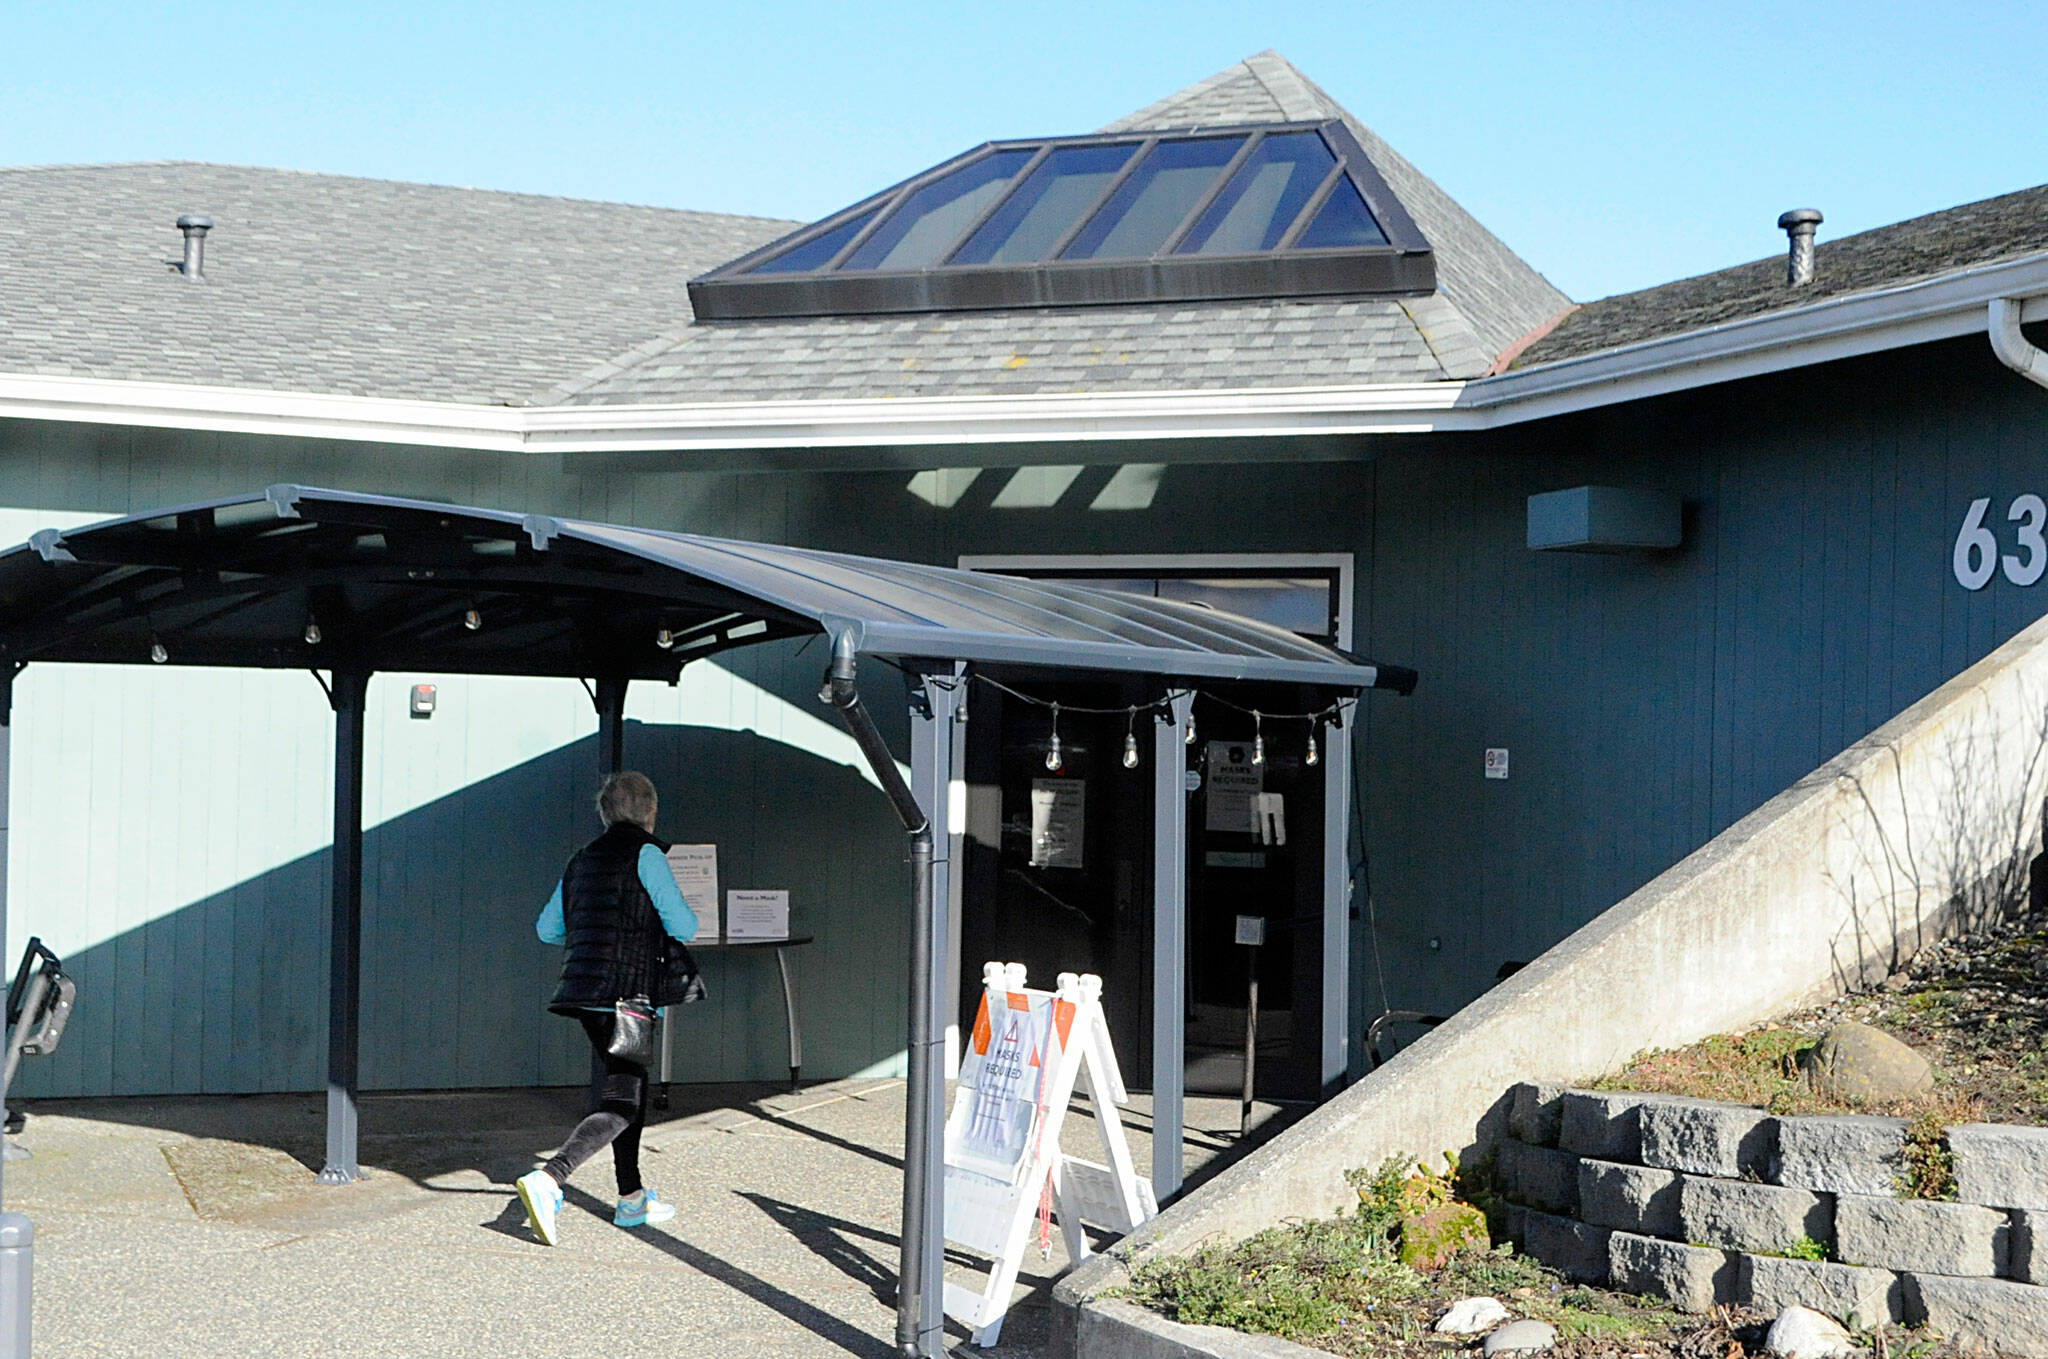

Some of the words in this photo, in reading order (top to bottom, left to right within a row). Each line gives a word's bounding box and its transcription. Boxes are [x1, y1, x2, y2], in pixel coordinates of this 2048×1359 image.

[1953, 494, 2047, 591] 63
[1212, 775, 1259, 785] REQUIRED
[997, 1049, 1020, 1062] MASKS
[985, 1063, 1022, 1079] REQUIRED
